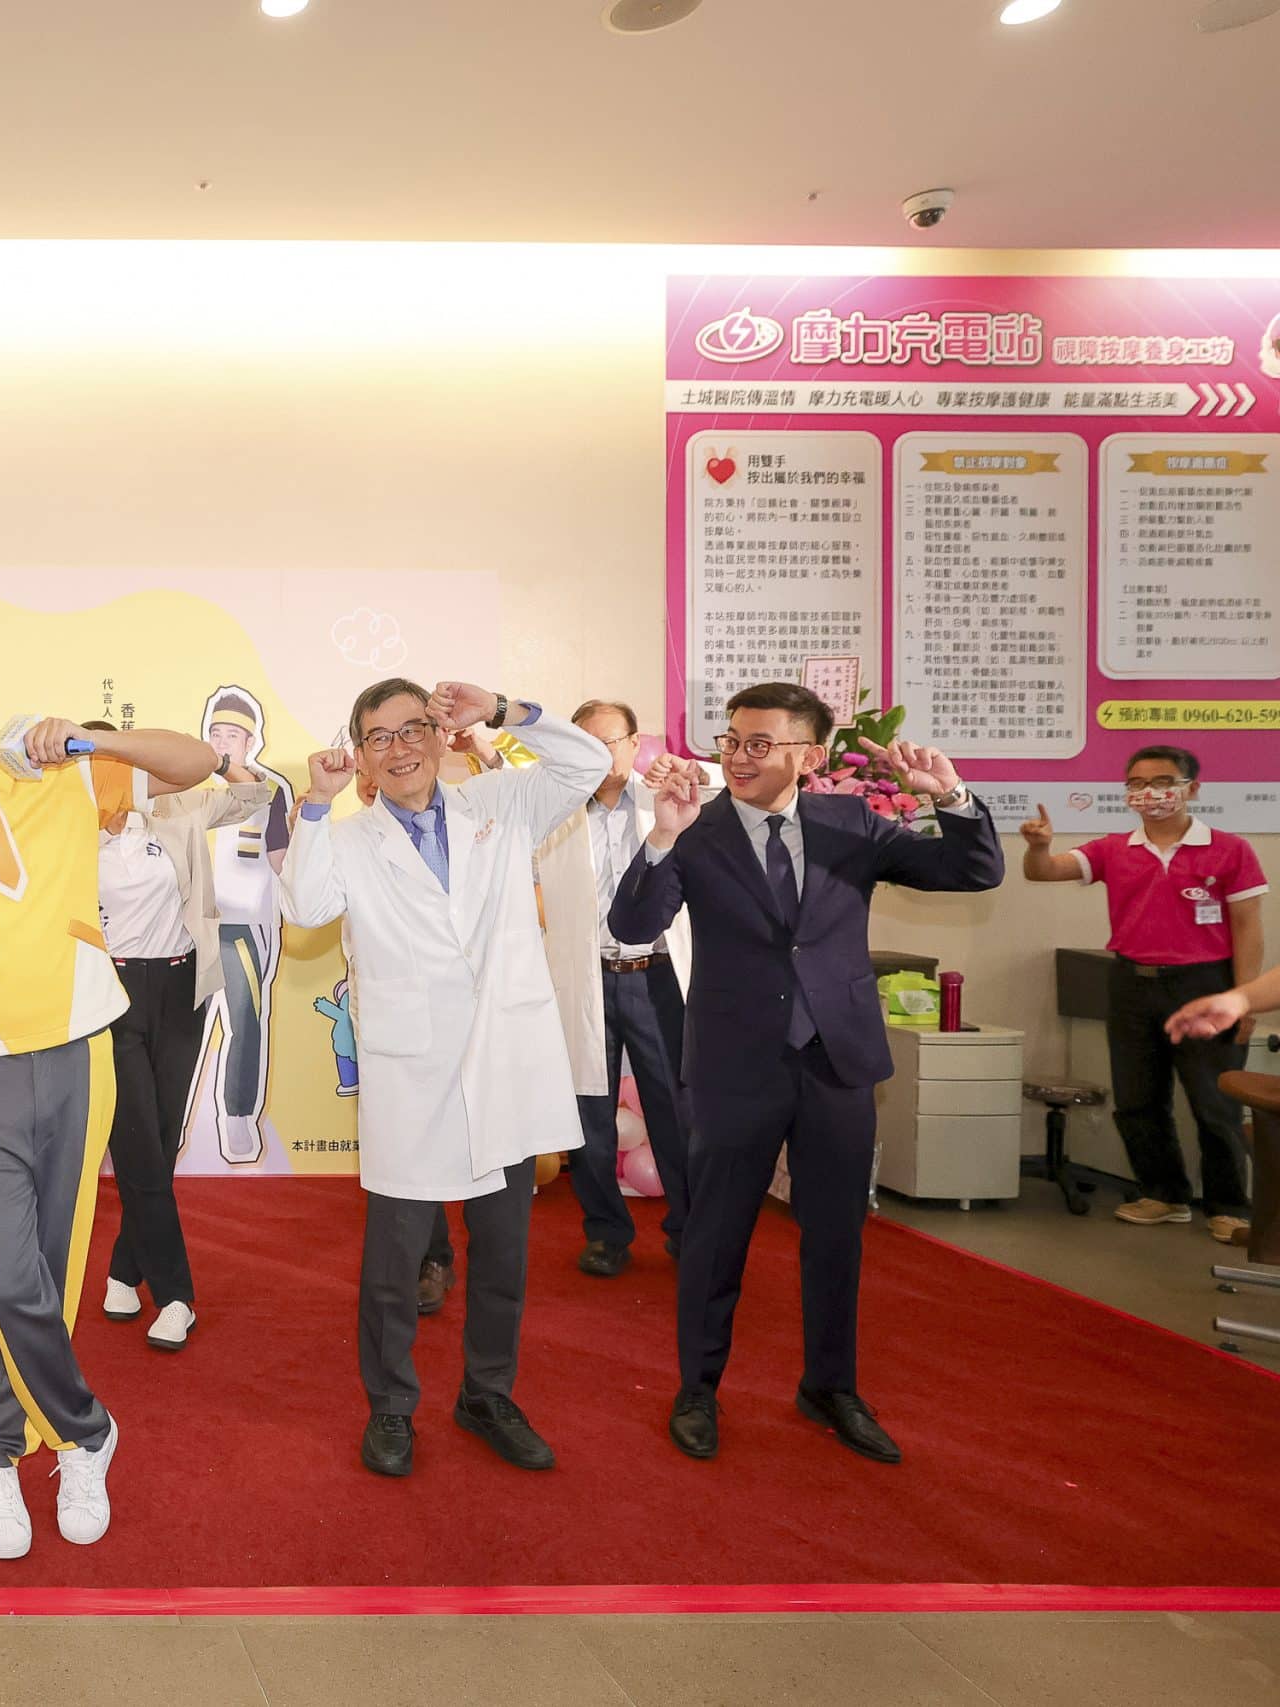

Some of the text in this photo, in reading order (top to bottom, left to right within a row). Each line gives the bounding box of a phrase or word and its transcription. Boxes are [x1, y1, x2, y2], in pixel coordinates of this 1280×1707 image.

[791, 308, 1043, 365] 摩力充電站
[102, 678, 113, 718] 代言人
